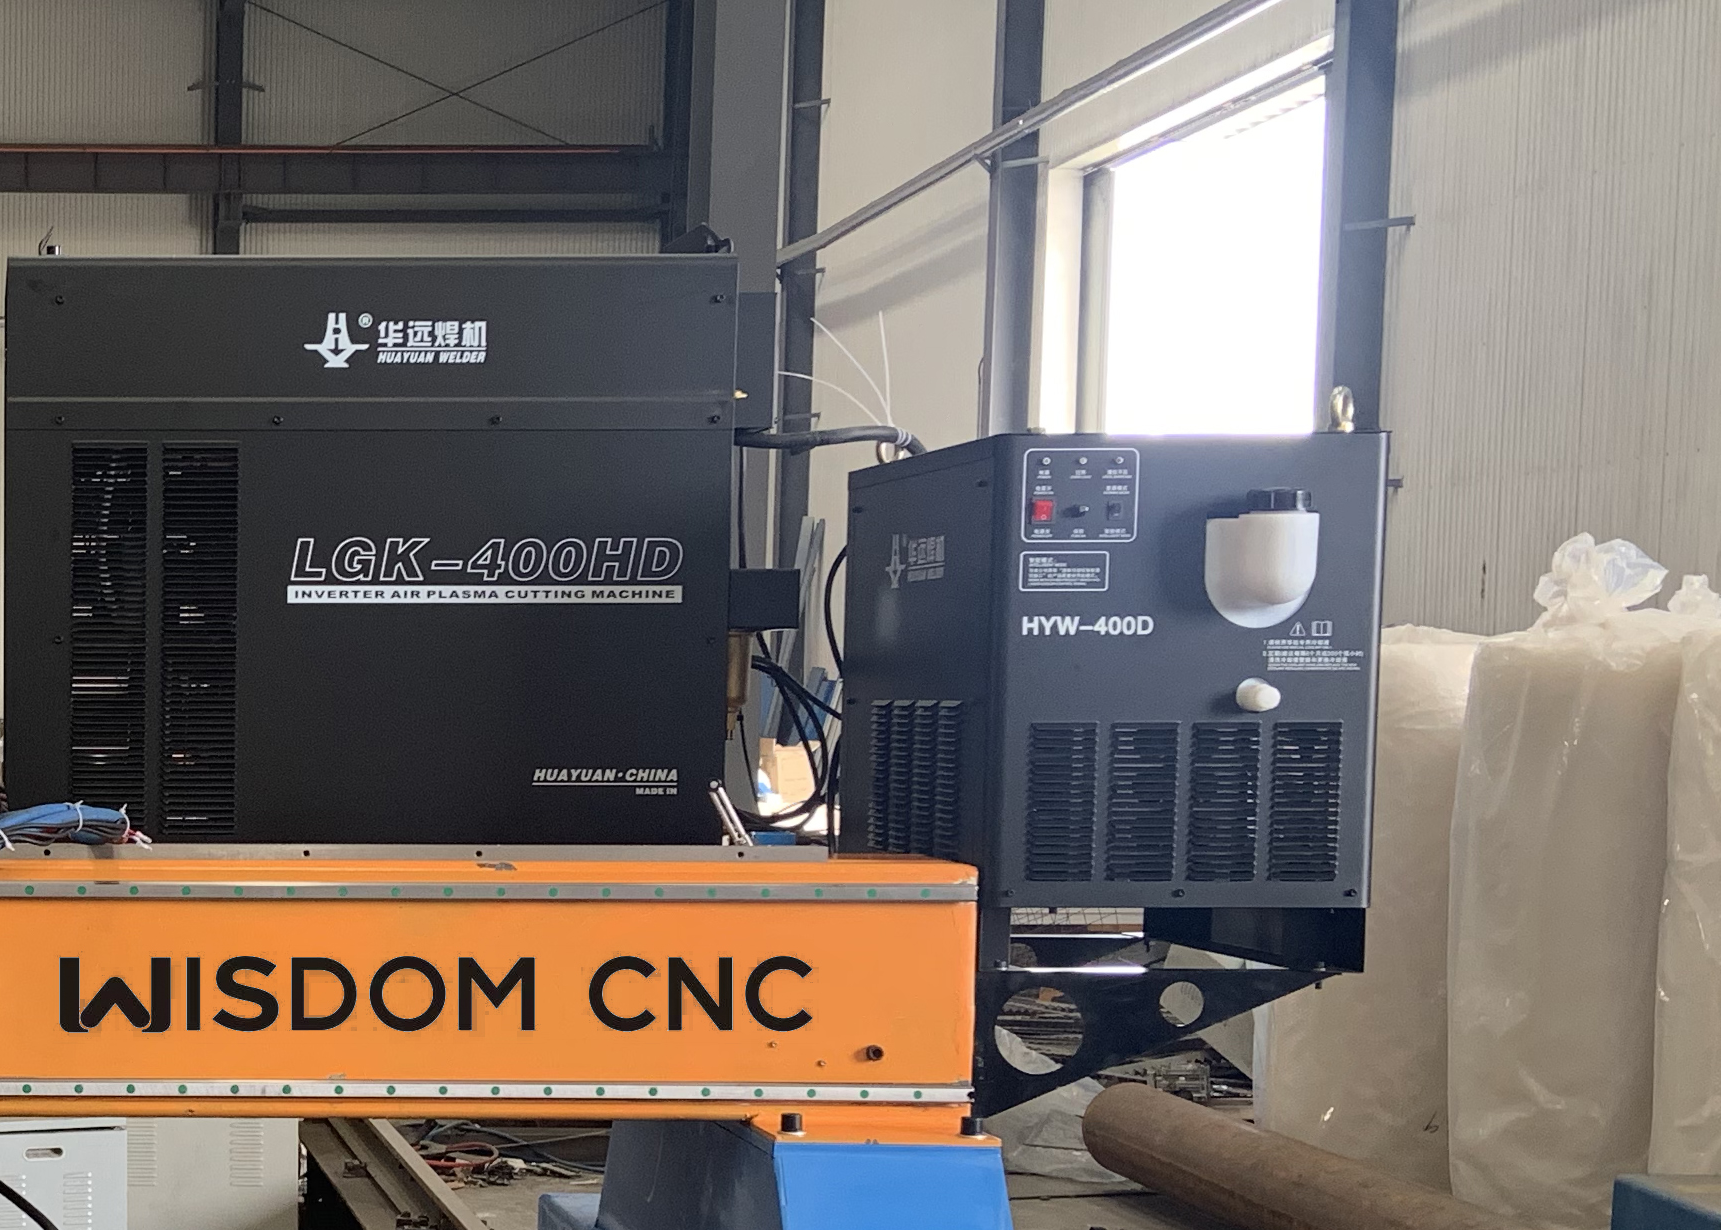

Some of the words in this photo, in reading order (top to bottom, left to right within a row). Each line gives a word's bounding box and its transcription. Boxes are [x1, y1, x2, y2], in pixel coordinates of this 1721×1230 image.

[377, 320, 487, 347] 华远焊机
[377, 351, 434, 364] HUAYUAN
[438, 351, 486, 364] WELDER
[290, 536, 683, 581] LGK-400HD
[294, 589, 385, 599] INVERTER
[390, 589, 421, 599] AIR
[427, 589, 499, 599] PLASMA
[505, 589, 586, 599] CUTTING
[590, 589, 675, 599] MACHINE
[1022, 615, 1154, 636] HYW-400D
[635, 787, 664, 795] MADE
[666, 787, 678, 795] IN
[58, 955, 536, 1033] WISDOM
[588, 955, 814, 1033] CNC
